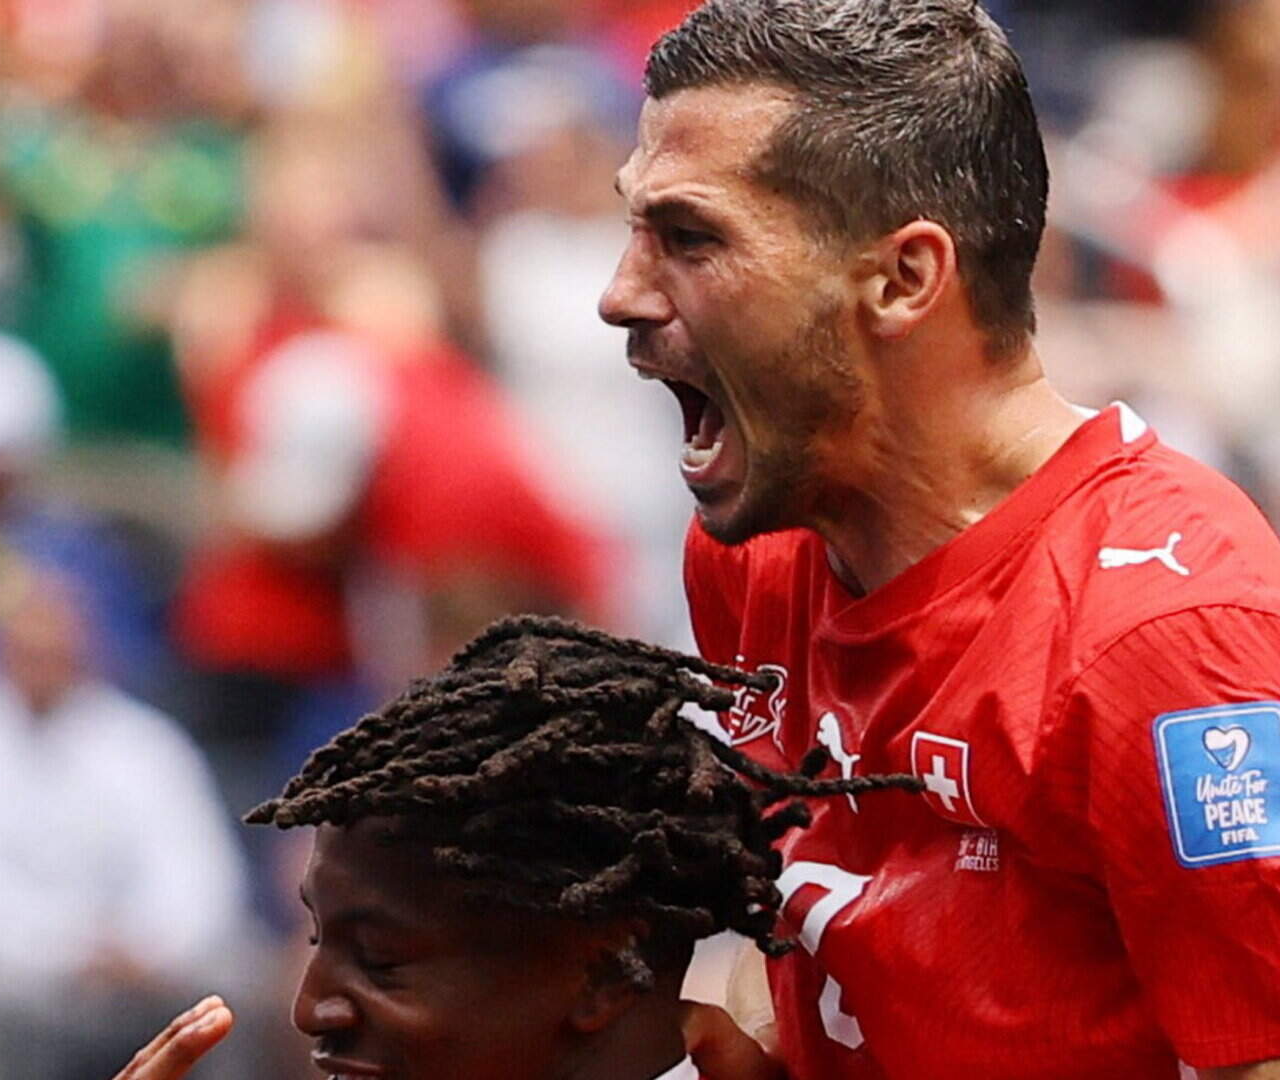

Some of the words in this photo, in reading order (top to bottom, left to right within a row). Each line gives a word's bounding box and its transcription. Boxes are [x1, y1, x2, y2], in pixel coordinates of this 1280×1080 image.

[1241, 769, 1269, 797] For
[1204, 798, 1269, 831] PEACE
[1221, 827, 1261, 846] FIFA
